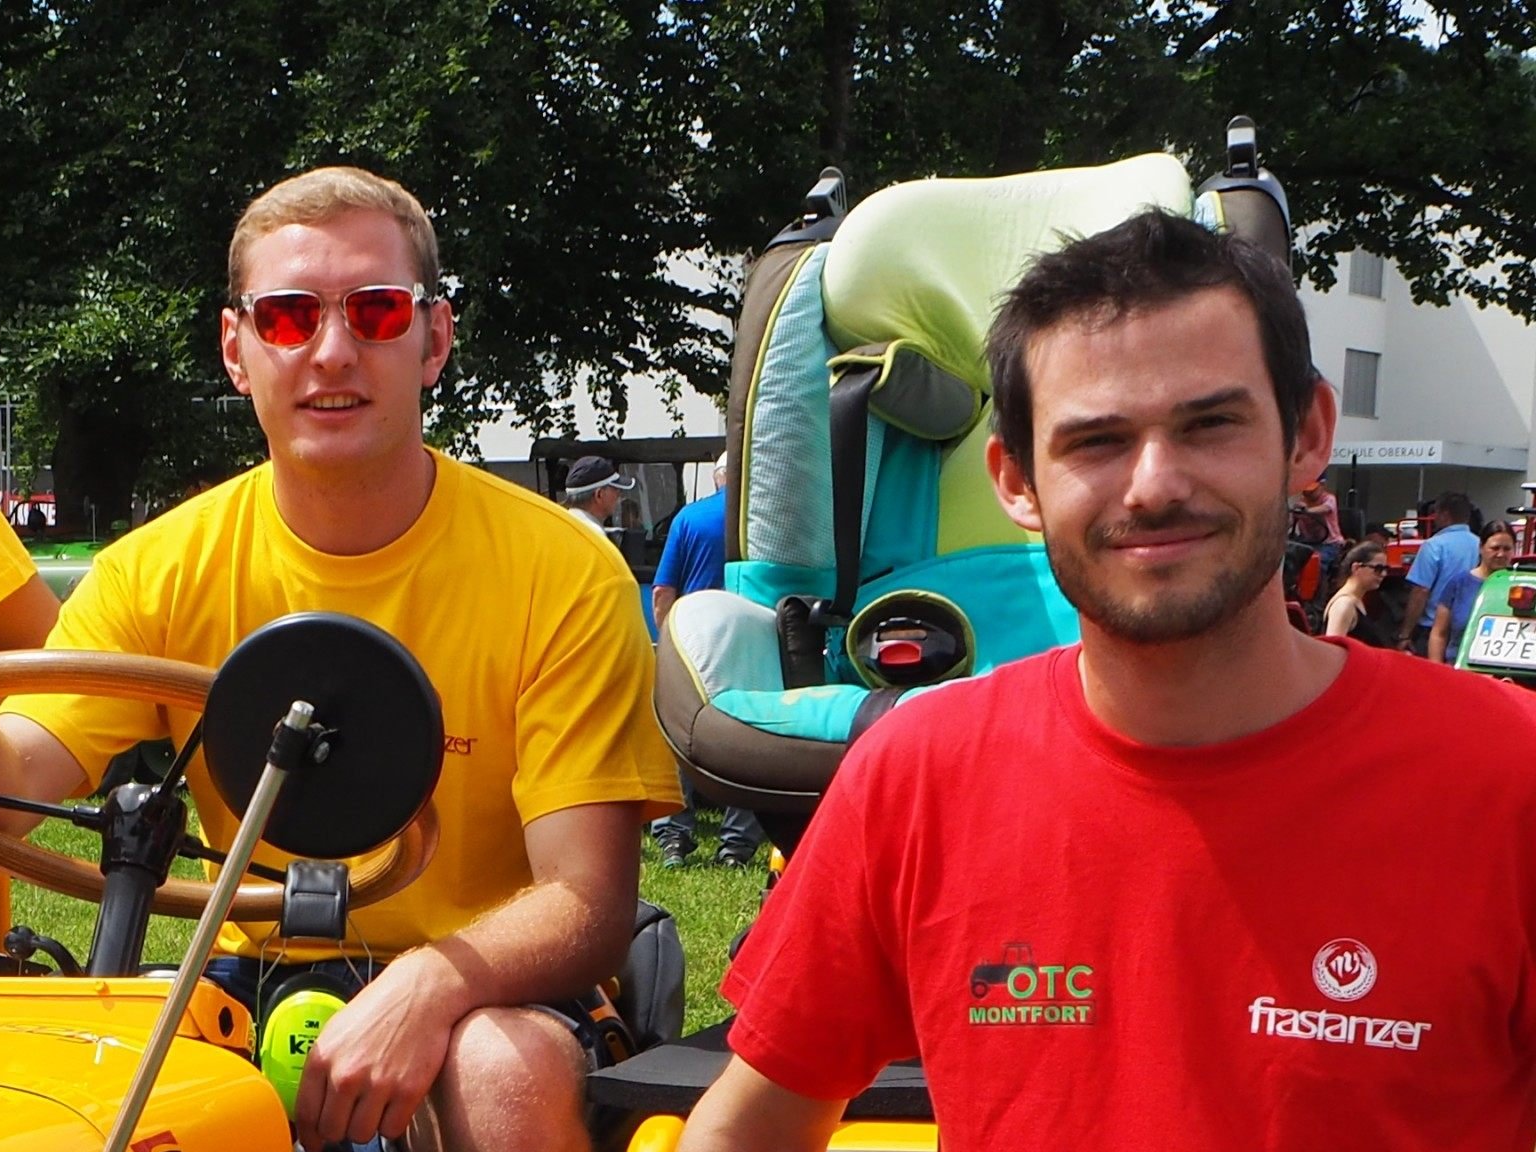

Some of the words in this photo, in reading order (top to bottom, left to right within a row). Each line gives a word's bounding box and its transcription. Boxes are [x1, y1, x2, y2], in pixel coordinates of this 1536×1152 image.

[1377, 447, 1424, 457] OBERAU
[1503, 621, 1531, 640] FK
[1483, 640, 1517, 657] 137
[1007, 965, 1095, 1000] OTC
[305, 1020, 320, 1029] 3M
[969, 1005, 1091, 1025] MONTFORT
[1248, 997, 1432, 1050] frastanzer
